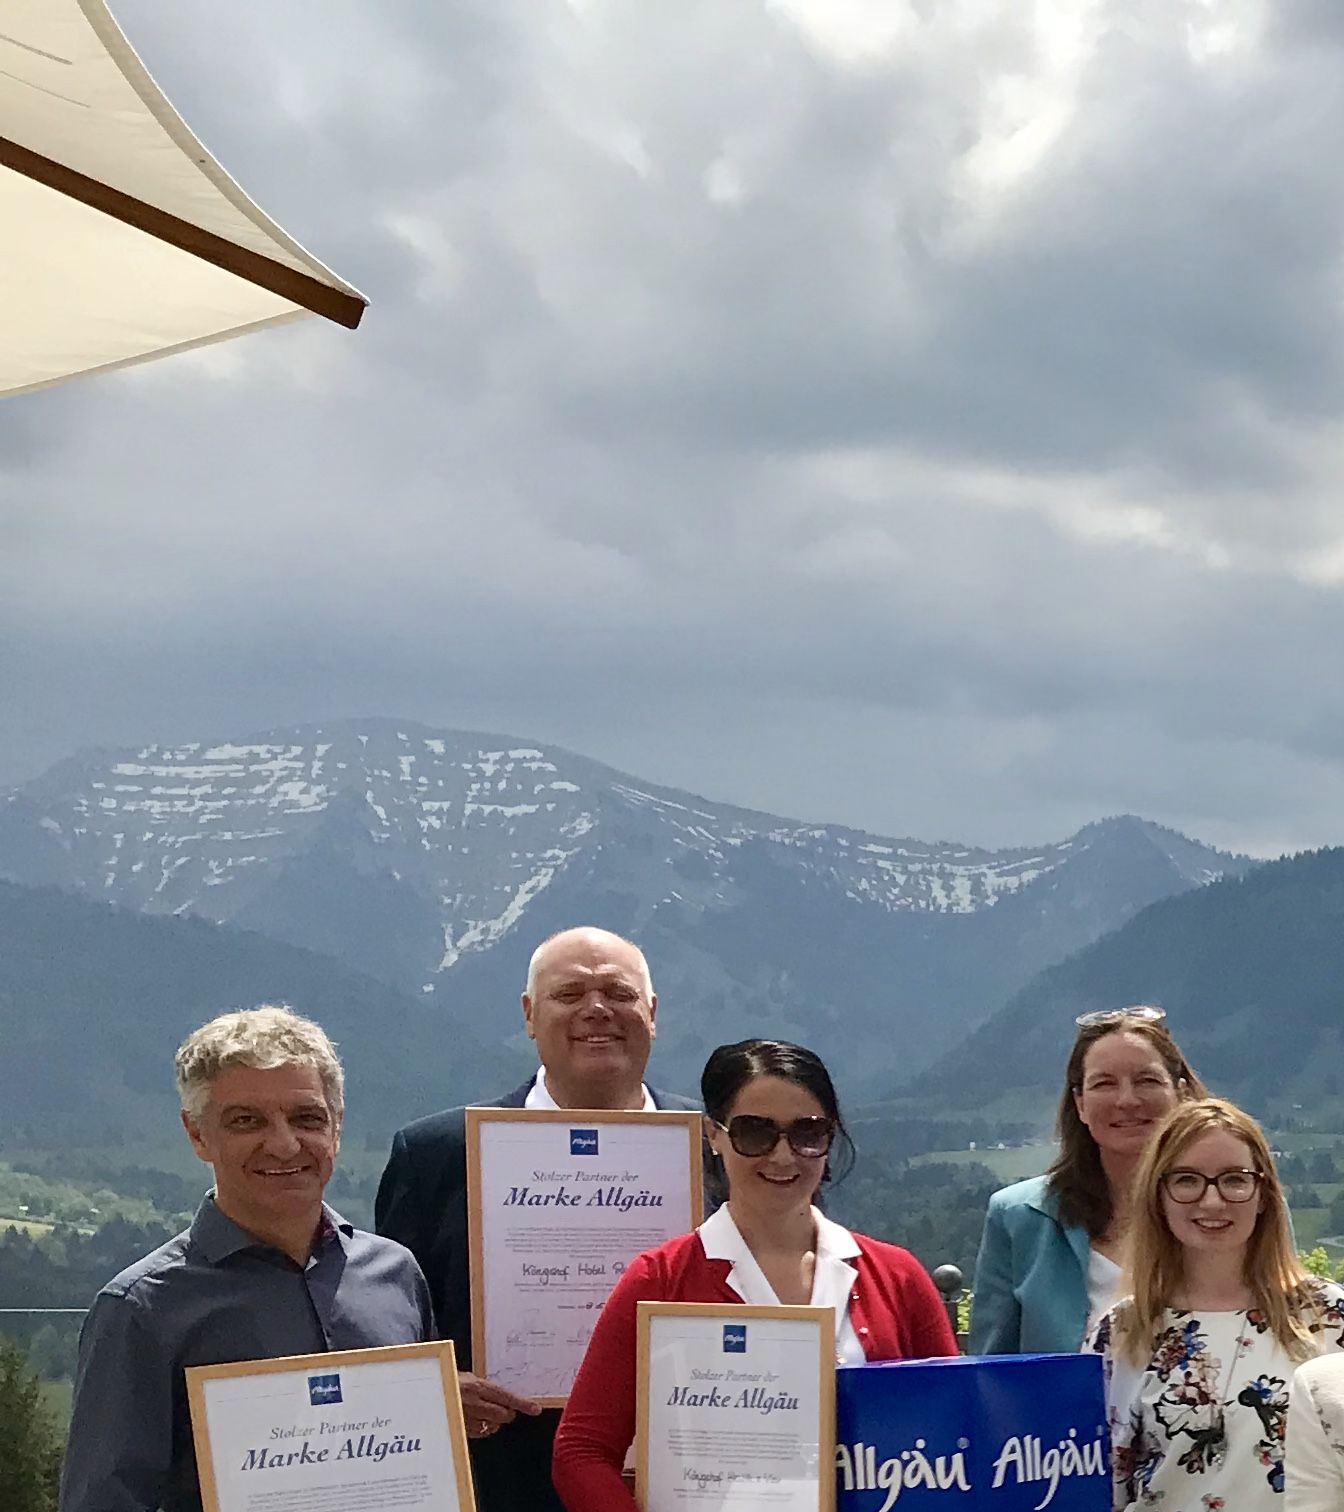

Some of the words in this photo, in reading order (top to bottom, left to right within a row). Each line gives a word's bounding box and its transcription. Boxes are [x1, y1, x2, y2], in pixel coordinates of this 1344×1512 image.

[532, 1170, 573, 1183] Stolzer
[575, 1170, 619, 1183] Partner
[621, 1171, 639, 1183] der
[503, 1186, 582, 1207] Marke
[586, 1187, 664, 1212] Allgäu
[689, 1368, 725, 1383] Stolzer
[726, 1369, 762, 1384] Partner
[763, 1370, 780, 1384] der
[666, 1386, 731, 1408] Marke
[734, 1388, 800, 1415] Allgäu
[269, 1424, 316, 1441] Stolzer
[319, 1420, 369, 1437] Partner
[371, 1416, 392, 1430] der
[240, 1445, 330, 1472] Marke
[336, 1434, 422, 1469] Allgäu
[992, 1428, 1106, 1511] Allgäu
